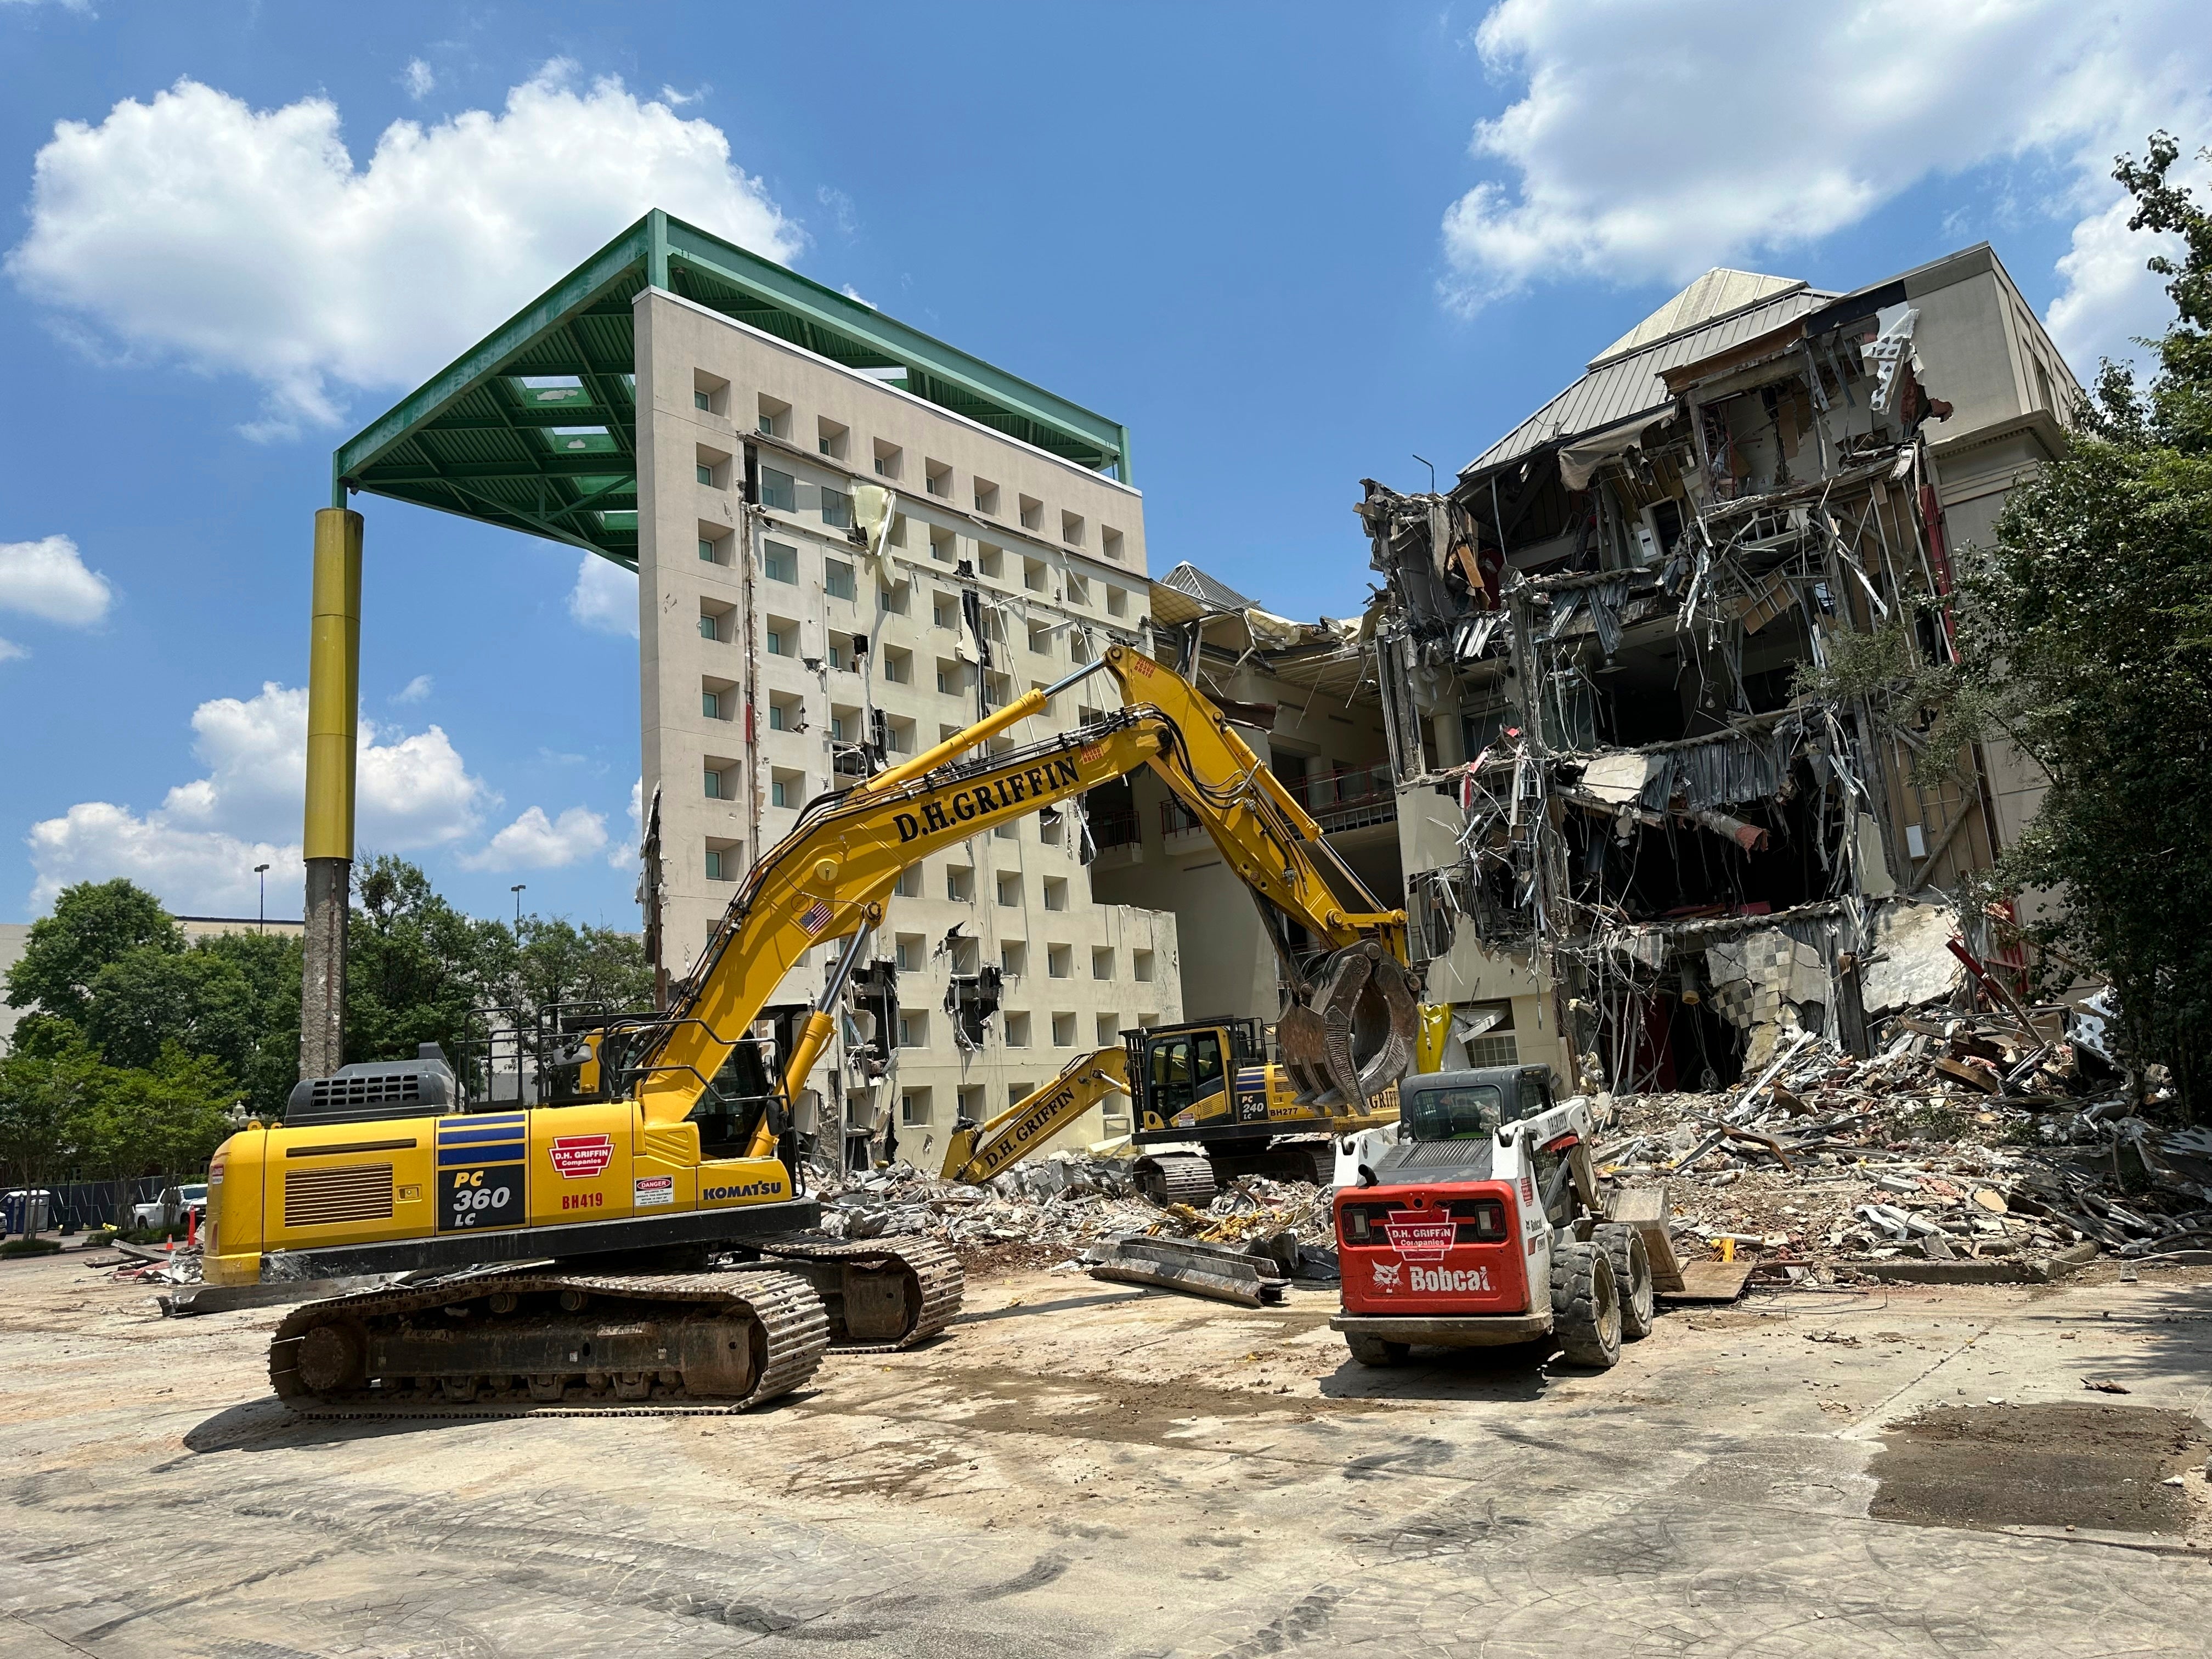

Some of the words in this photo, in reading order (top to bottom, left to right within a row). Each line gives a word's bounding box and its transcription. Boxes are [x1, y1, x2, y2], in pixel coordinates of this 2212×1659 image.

[1243, 1102, 1264, 1113] 240
[1270, 1108, 1298, 1116] BH277
[984, 1138, 1017, 1169] D.H.
[1016, 1087, 1075, 1142] GRIFFIN
[562, 1158, 602, 1166] Companies
[574, 1149, 608, 1159] GRIFFIN
[453, 1171, 484, 1188] PC
[703, 1181, 781, 1200] KOMATSU
[453, 1187, 510, 1211] 360
[562, 1192, 602, 1210] BH419
[454, 1212, 476, 1227] LC
[1413, 1228, 1451, 1238] GRIFFIN
[1409, 1266, 1491, 1291] Bobcat
